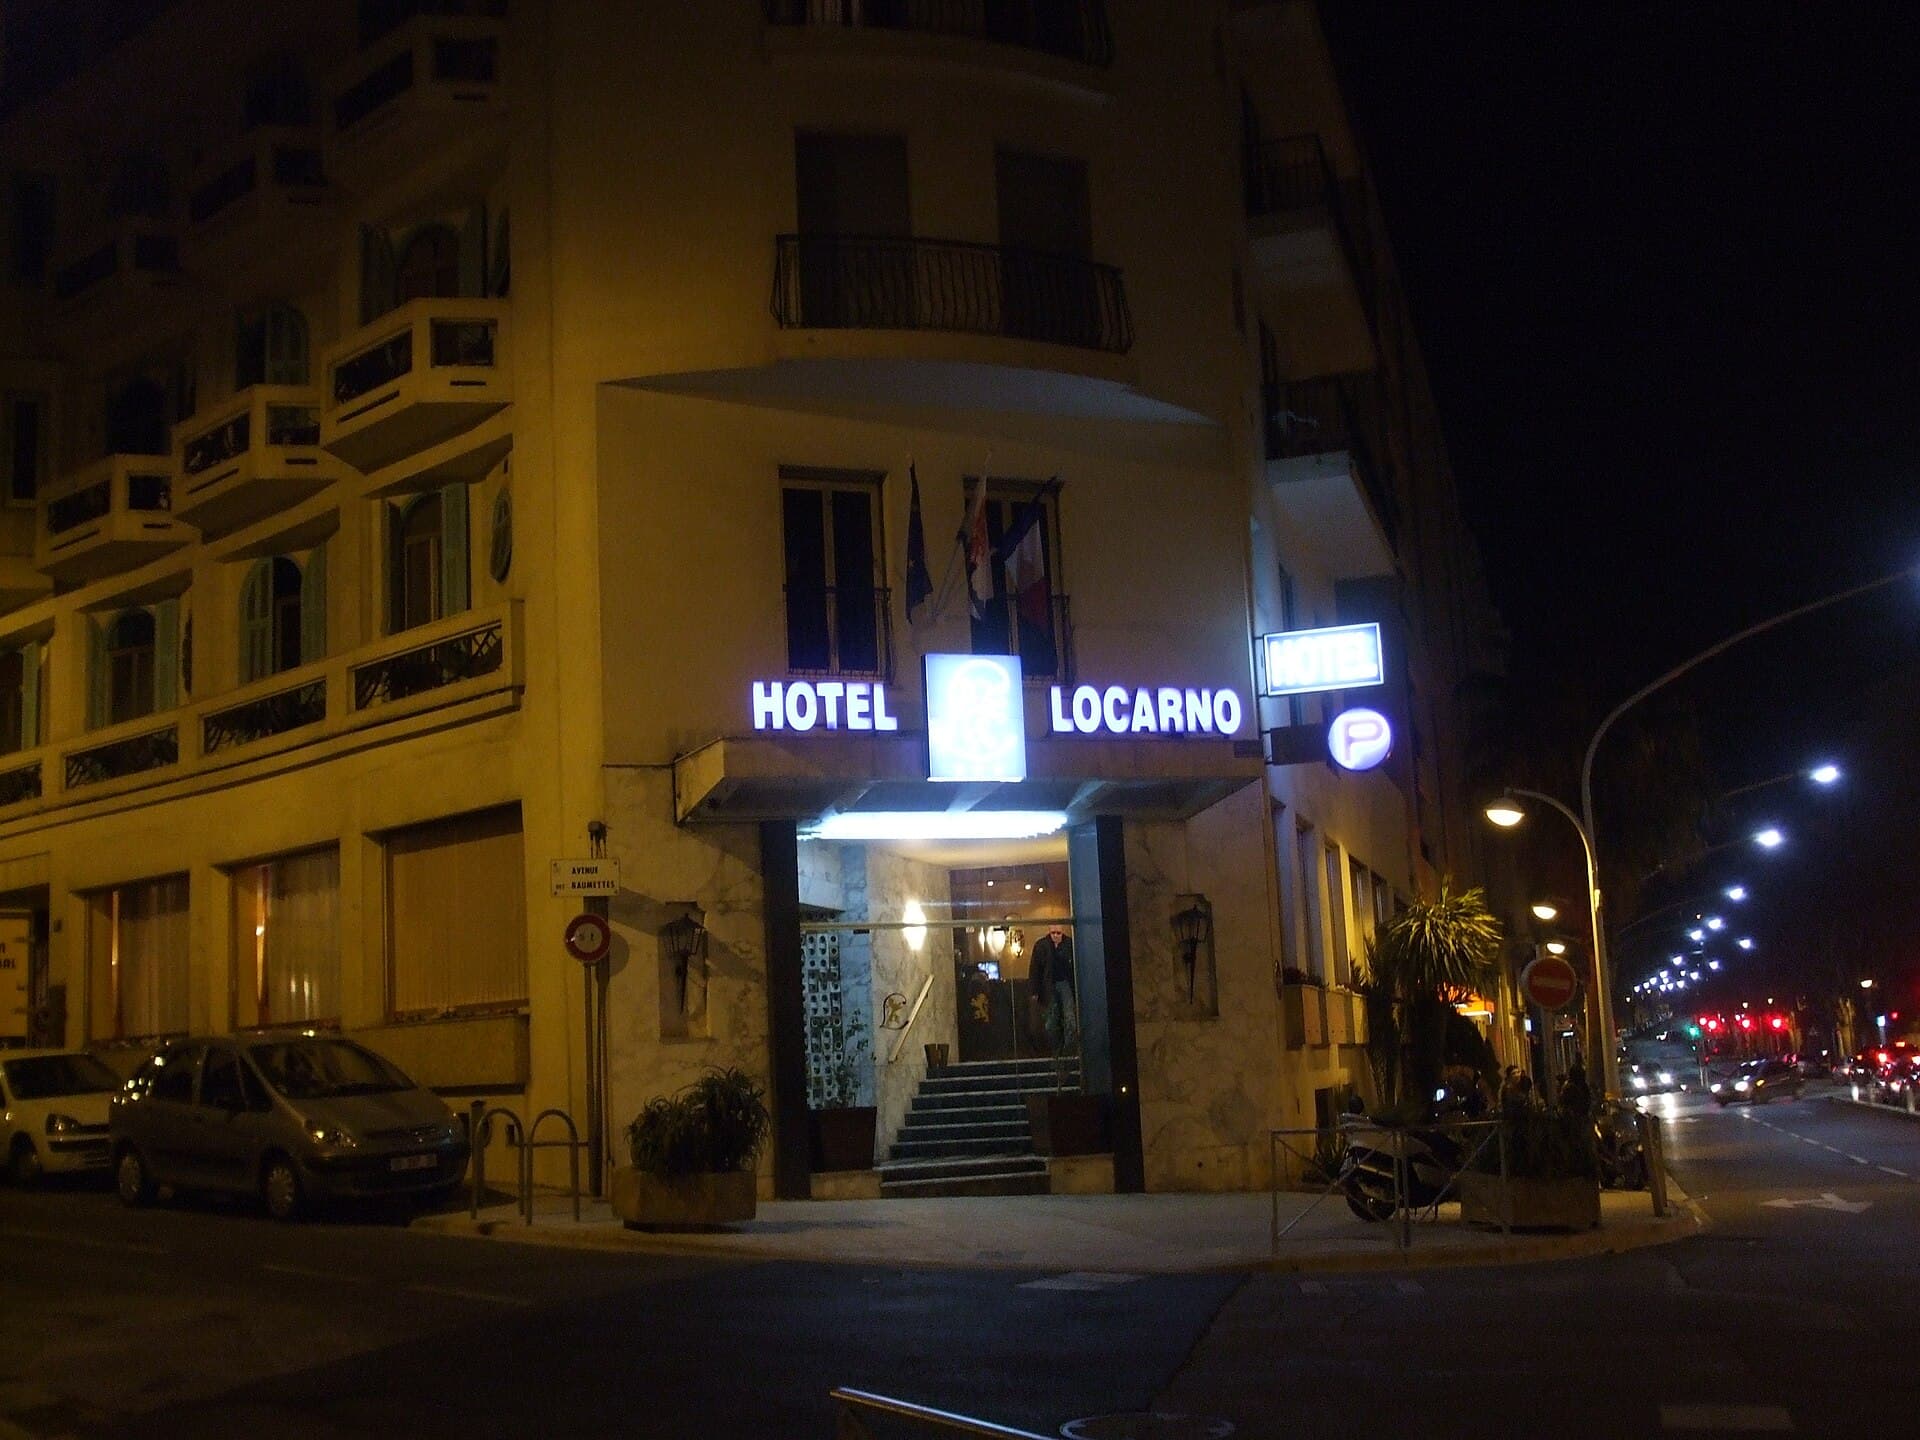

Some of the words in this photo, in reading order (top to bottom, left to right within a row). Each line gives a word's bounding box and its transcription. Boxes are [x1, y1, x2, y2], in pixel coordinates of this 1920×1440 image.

[752, 681, 898, 731] HOTEL
[1050, 685, 1241, 735] LOCARNO
[1343, 719, 1384, 762] P
[571, 866, 598, 875] AVENUE
